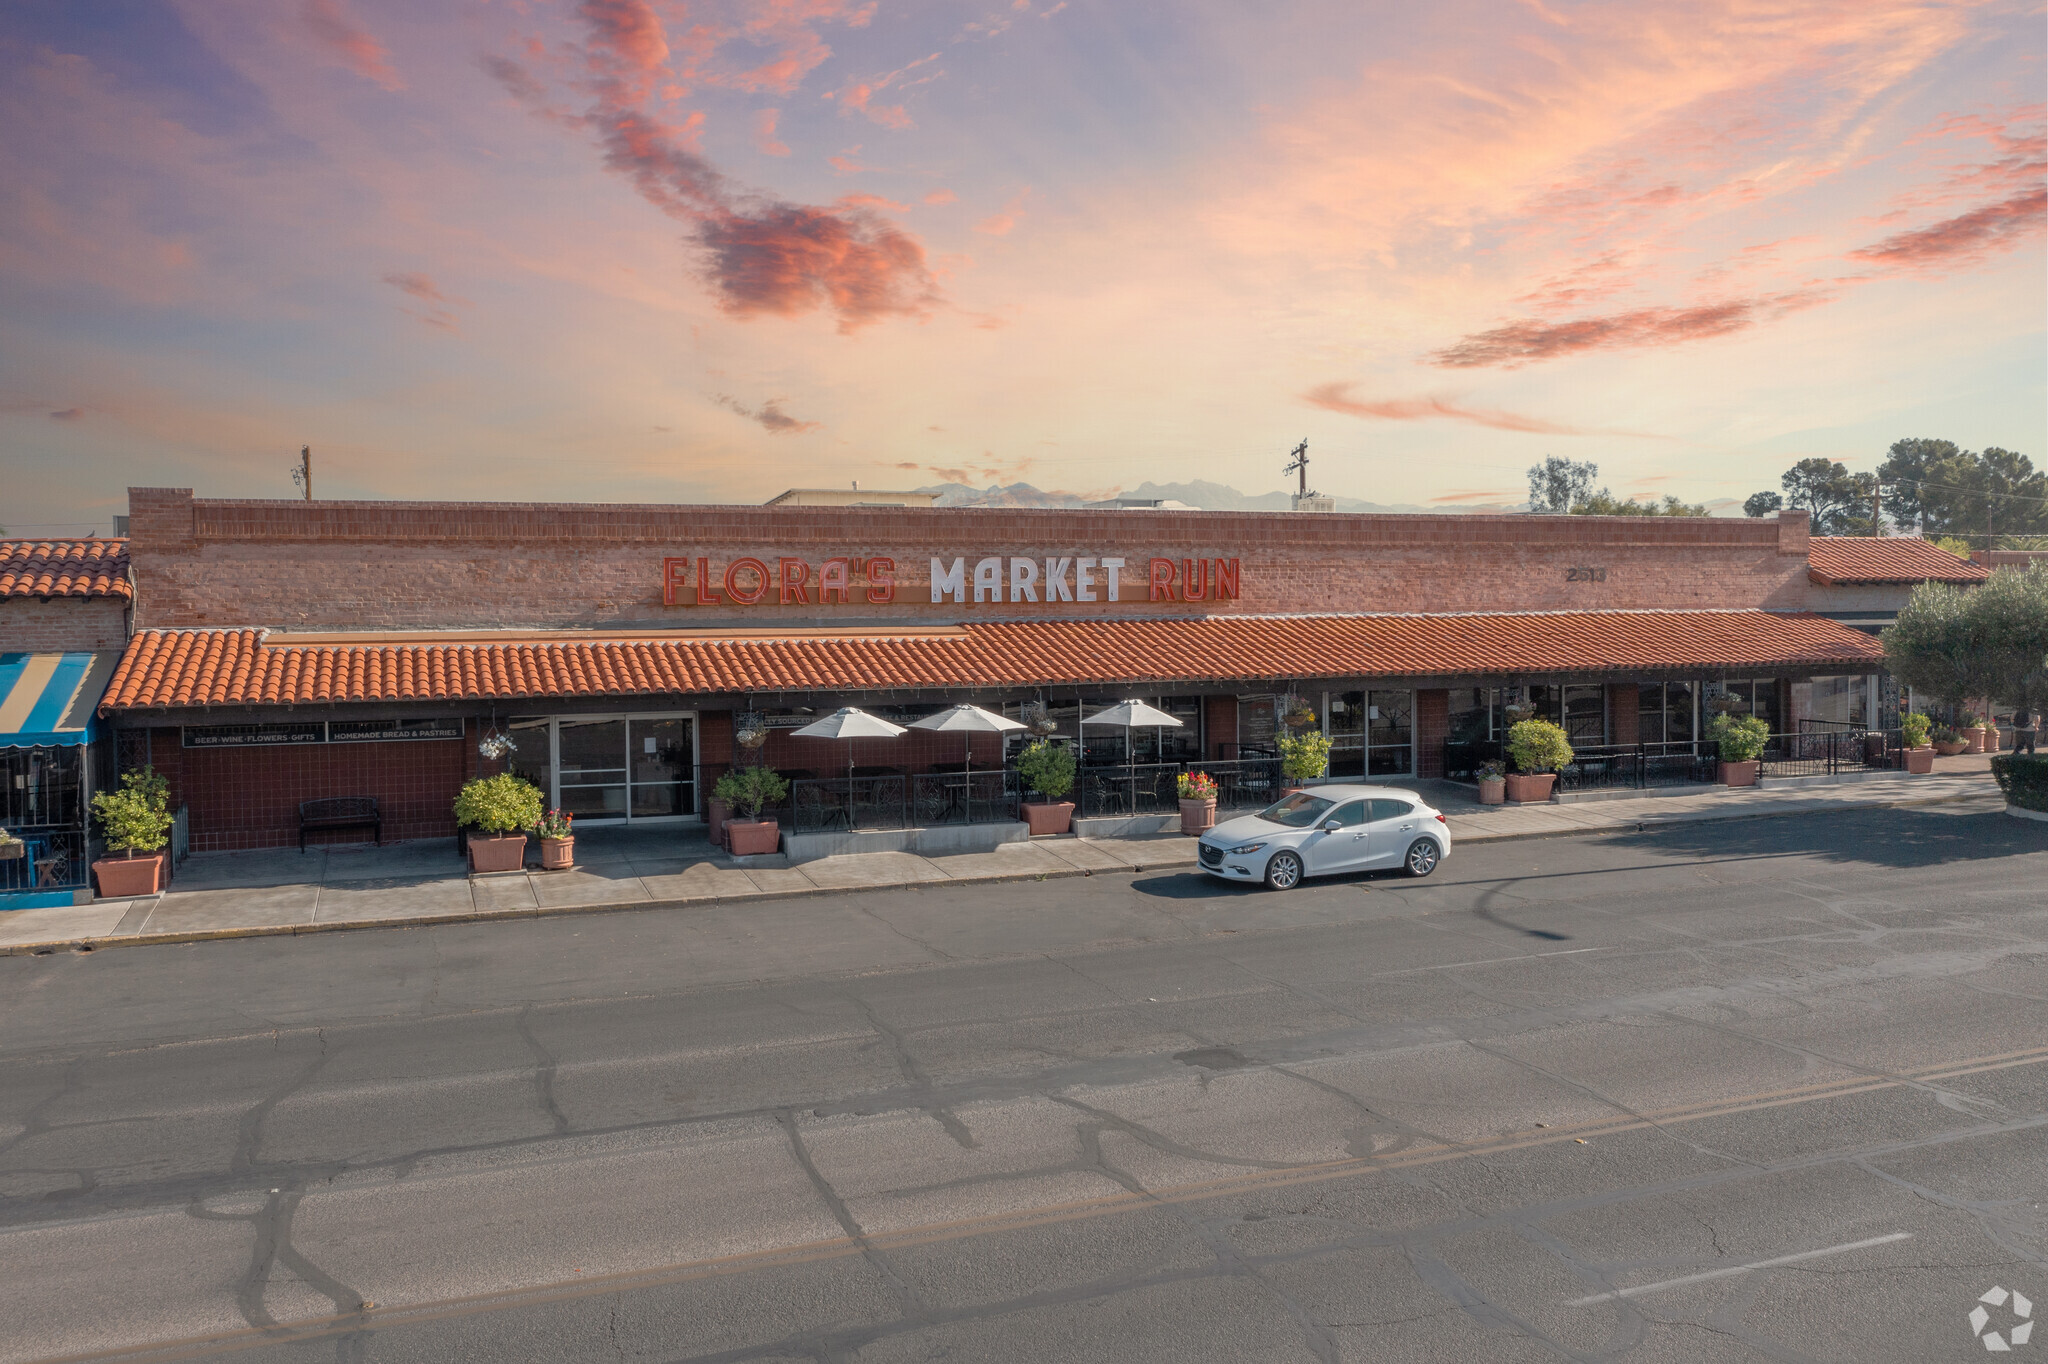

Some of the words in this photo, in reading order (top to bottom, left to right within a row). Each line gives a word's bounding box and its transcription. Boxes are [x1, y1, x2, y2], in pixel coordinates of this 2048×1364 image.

[663, 556, 895, 605] FLORA'S
[930, 557, 1125, 603] MARKET
[1149, 557, 1240, 602] RUN
[195, 736, 218, 744] BEER
[221, 735, 243, 743] WINE
[247, 734, 288, 742] FLOWERS
[334, 731, 381, 740] HOMEMADE
[382, 730, 410, 738] BREAD
[420, 729, 457, 737] PASTRIES
